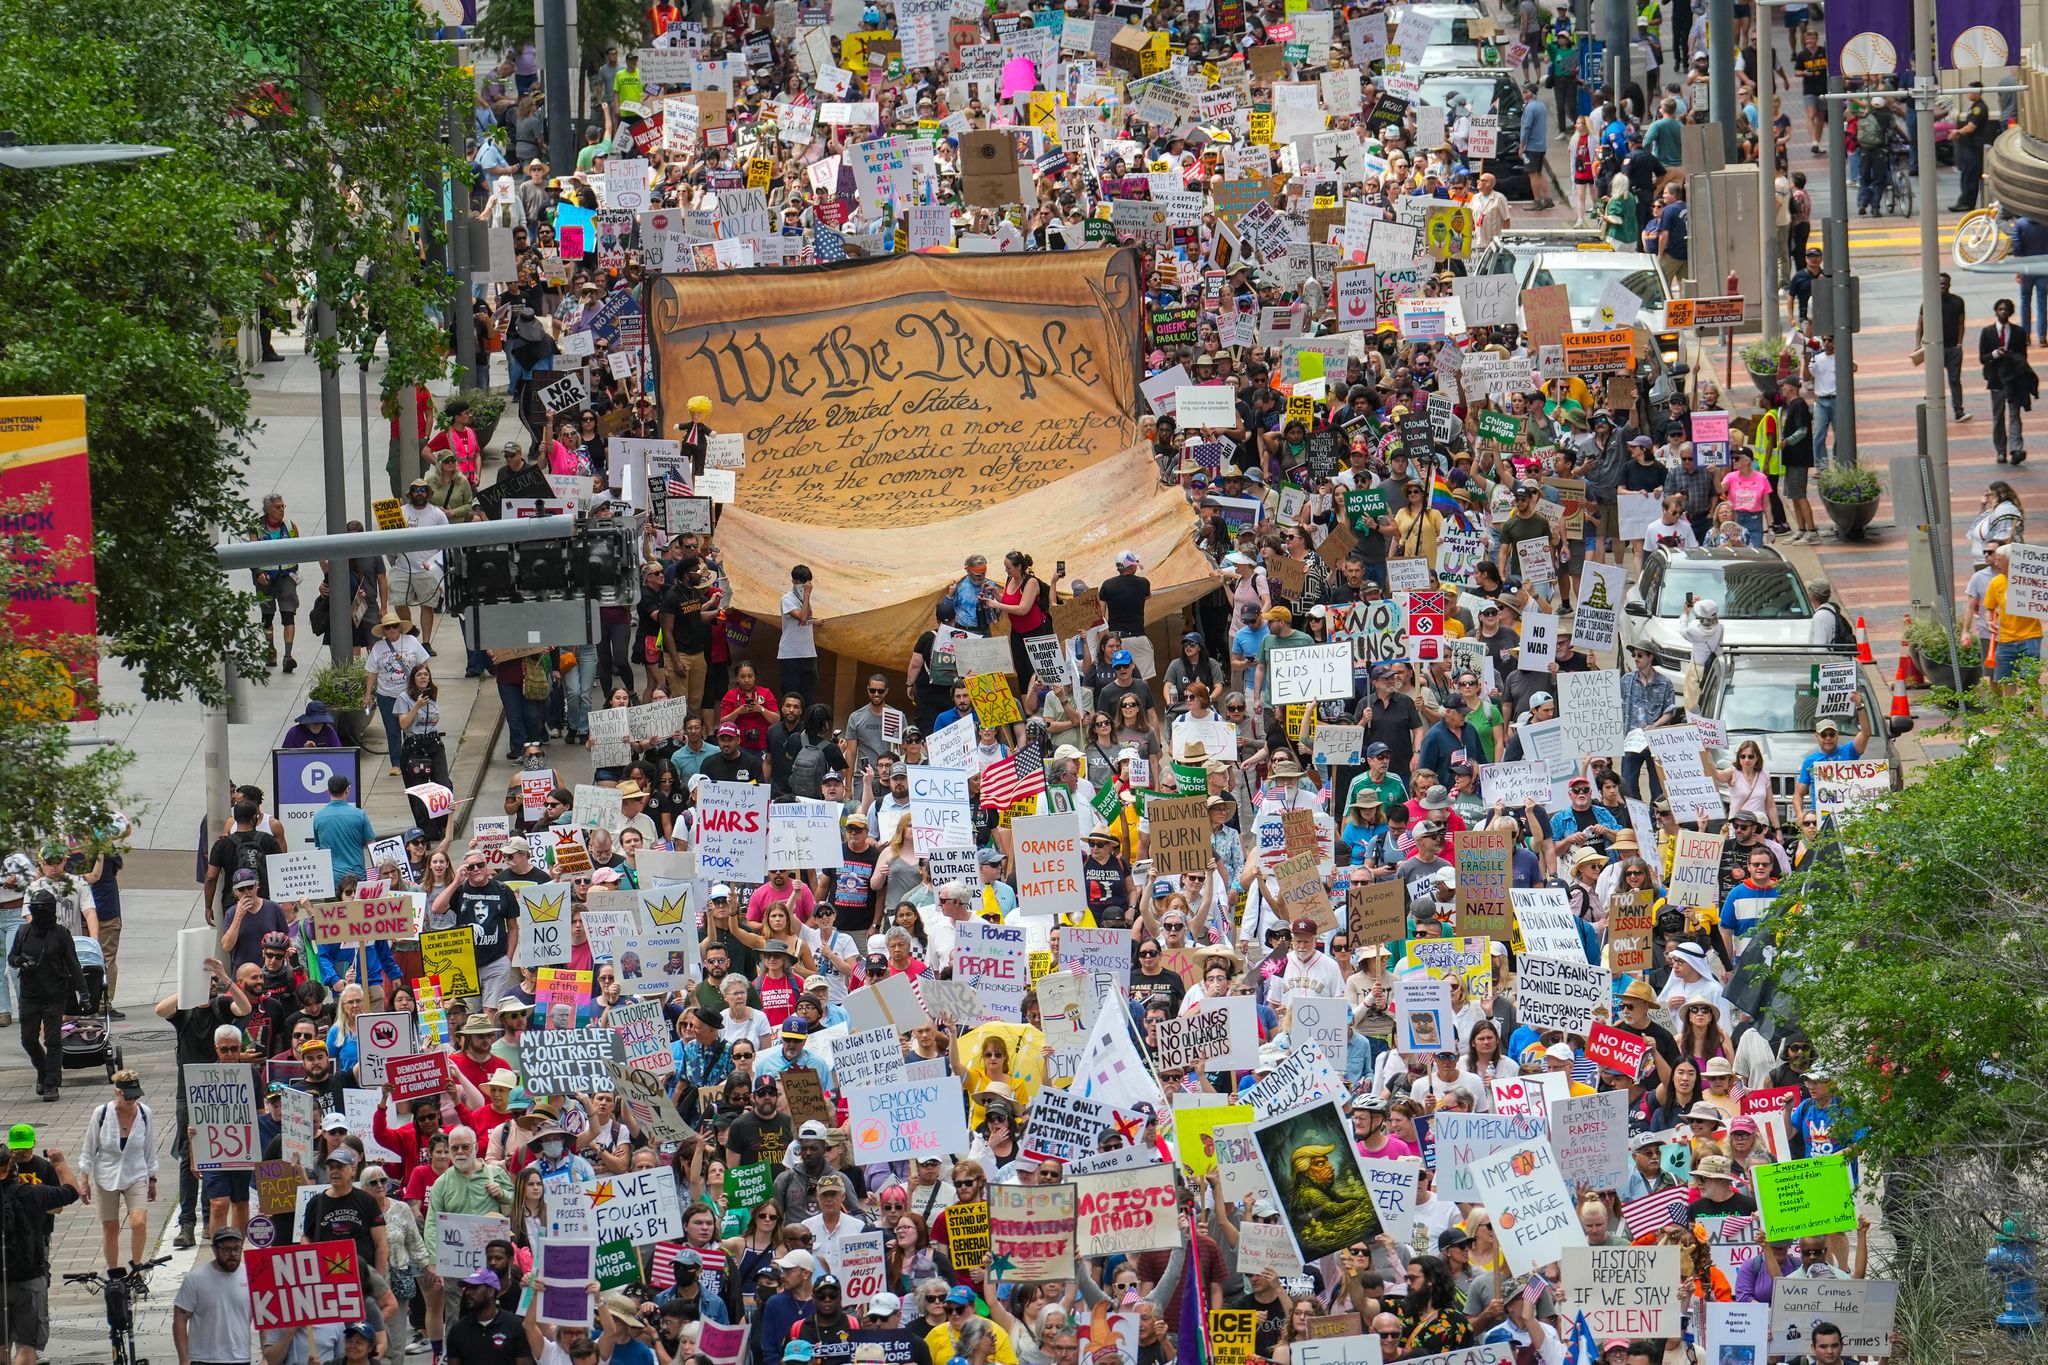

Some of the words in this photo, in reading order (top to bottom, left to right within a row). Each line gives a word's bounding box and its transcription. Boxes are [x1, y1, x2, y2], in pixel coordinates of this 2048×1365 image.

[1472, 118, 1496, 128] RELEASE
[1470, 137, 1495, 145] EPSTEIN
[752, 160, 770, 170] ICE
[1290, 259, 1309, 270] DUMP
[1315, 260, 1338, 270] TRUMP
[1346, 279, 1366, 288] HAVE
[1464, 282, 1510, 298] FUCK
[1340, 287, 1372, 296] FRIENDS
[1153, 311, 1172, 322] KINGS
[1182, 309, 1196, 319] BAD
[1476, 302, 1498, 319] ICE
[1156, 320, 1186, 333] QUEENS
[1340, 317, 1374, 325] EVERYWHERE
[1156, 331, 1196, 343] FABULOUS
[1567, 336, 1580, 344] ICE
[1582, 335, 1606, 344] MUST
[1610, 334, 1625, 342] GO!
[686, 331, 816, 406] We
[811, 325, 904, 398] the
[895, 308, 1100, 399] People
[547, 379, 572, 400] NO
[547, 386, 587, 413] WAR
[747, 415, 784, 445] of
[776, 408, 820, 437] the
[826, 390, 902, 428] United
[903, 387, 992, 414] States,
[1485, 416, 1514, 432] Chinga
[1479, 423, 1492, 432] La
[1493, 426, 1516, 440] Migra.
[752, 436, 832, 463] order
[837, 427, 866, 450] to
[869, 419, 929, 454] form
[941, 423, 954, 436] a
[963, 419, 1024, 434] more
[760, 460, 842, 481] insure
[850, 443, 954, 469] domestic
[963, 432, 1097, 457] tranquility.
[786, 478, 826, 495] for
[834, 471, 868, 490] the
[879, 466, 967, 484] common
[980, 457, 1074, 480] defence.
[1364, 494, 1379, 502] ICE
[1363, 503, 1384, 511] WAR
[1578, 608, 1615, 622] BILLIONAIRES
[1576, 619, 1586, 628] ARE
[1533, 626, 1545, 638] NO
[1575, 629, 1584, 639] ON
[1585, 631, 1594, 640] ALL
[1596, 633, 1604, 641] OF
[1605, 633, 1612, 643] US
[1027, 642, 1038, 652] NO
[1039, 639, 1058, 649] MORE
[1528, 641, 1548, 655] WAR
[1033, 648, 1057, 660] MONEY
[1273, 646, 1348, 664] DETAINING
[1040, 658, 1056, 667] FOR
[1275, 664, 1313, 677] KIDS
[1323, 661, 1334, 673] IS
[1037, 665, 1064, 676] ISRAEL'S
[1822, 668, 1853, 677] AMERICANS
[1041, 674, 1062, 684] WARS
[1278, 676, 1345, 696] EVIL
[1821, 683, 1854, 691] HEALTHCARE
[1827, 692, 1849, 703] NOT
[1821, 702, 1850, 713] WAR!
[1315, 730, 1362, 742] ABOLISH
[1327, 741, 1353, 754] ICE
[311, 769, 325, 785] P
[914, 779, 964, 800] CARE
[924, 808, 959, 825] OVER
[1159, 828, 1201, 849] BURN
[1462, 835, 1504, 848] SUPER
[1021, 839, 1074, 853] ORANGE
[1155, 853, 1173, 871] IN
[1180, 851, 1212, 870] HELL
[1458, 849, 1508, 863] CALLOUS
[1033, 860, 1065, 874] LIES
[1460, 861, 1505, 872] FRAGILE
[1460, 874, 1506, 886] RACIST
[1022, 879, 1077, 897] MATTER
[1465, 886, 1506, 899] LYING
[319, 907, 348, 920] WE
[364, 901, 403, 916] BOW
[1466, 902, 1504, 916] NAZI
[319, 923, 341, 937] TO
[349, 921, 372, 935] NO
[375, 918, 408, 933] ONE
[1464, 916, 1505, 930] POTUS
[534, 927, 557, 943] NO
[533, 944, 561, 956] KINGS
[553, 970, 577, 981] Lord
[550, 982, 558, 991] of
[561, 982, 578, 991] the
[551, 992, 575, 1002] Files
[1160, 1020, 1182, 1036] NO
[1186, 1008, 1228, 1030] KINGS
[1160, 1036, 1180, 1052] NO
[1181, 1024, 1228, 1046] OLIGARCHS
[1161, 1052, 1182, 1068] NO
[1184, 1040, 1230, 1064] FASCISTS
[396, 1059, 436, 1075] DEMOCRACY
[394, 1073, 421, 1085] DOESN'T
[421, 1068, 442, 1080] WORK
[400, 1083, 409, 1092] AT
[410, 1077, 441, 1091] GUNPOINT
[190, 1084, 248, 1101] PATRIOTIC
[869, 1086, 938, 1111] DEMOCRACY
[1044, 1091, 1067, 1106] THE
[1071, 1099, 1102, 1117] ONLY
[195, 1104, 222, 1123] DUTY
[219, 1104, 232, 1121] TO
[232, 1104, 253, 1121] CALL
[890, 1106, 926, 1123] NEEDS
[1033, 1106, 1111, 1134] MINORITY
[895, 1120, 922, 1136] YOUR
[209, 1124, 252, 1159] BS!
[890, 1131, 939, 1153] COURAGE
[1029, 1124, 1091, 1147] DESTROYING
[730, 1164, 766, 1178] Secrets
[738, 1176, 762, 1188] keep
[734, 1182, 766, 1200] rapists
[741, 1193, 763, 1206] safe.
[845, 1239, 879, 1253] EVERYONE
[1591, 1250, 1657, 1269] HISTORY
[273, 1250, 321, 1286] NO
[851, 1268, 876, 1276] MUST
[1593, 1268, 1646, 1284] REPEATS
[847, 1274, 883, 1298] GO!
[1574, 1287, 1593, 1303] IF
[1601, 1288, 1625, 1305] WE
[1633, 1286, 1670, 1304] STAY
[253, 1283, 360, 1327] KINGS
[1214, 1313, 1252, 1332] ICE
[1592, 1310, 1662, 1333] SILENT
[1213, 1332, 1251, 1343] OUT!
